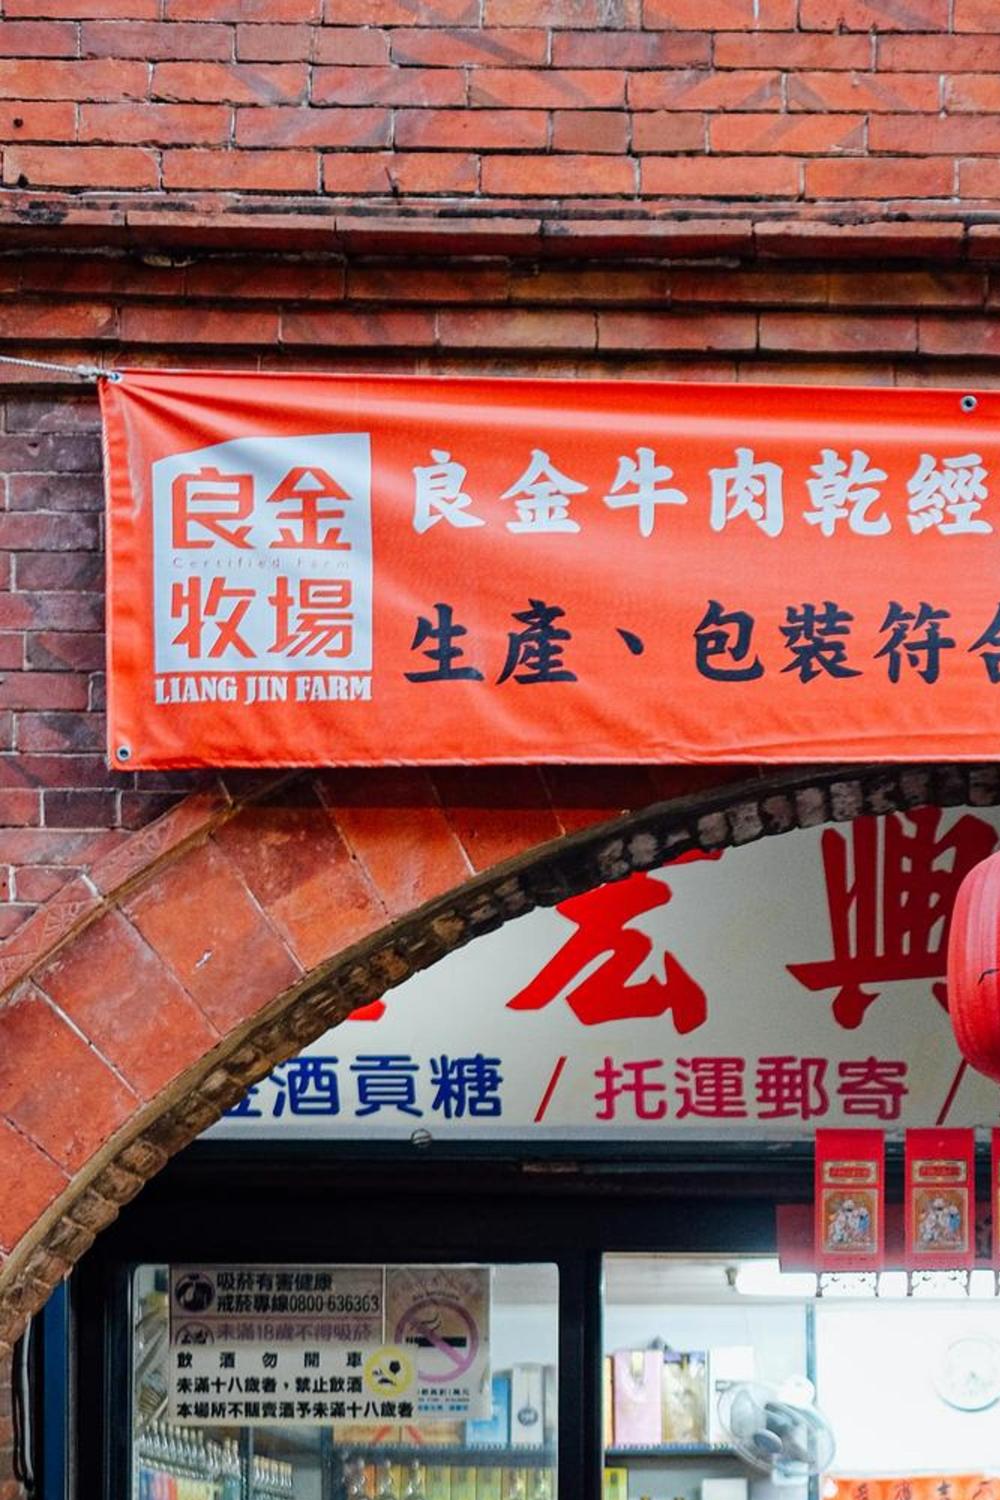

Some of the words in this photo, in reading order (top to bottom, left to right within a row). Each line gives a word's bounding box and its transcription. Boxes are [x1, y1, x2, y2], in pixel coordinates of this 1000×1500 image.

[172, 467, 353, 549] 良金
[173, 557, 280, 568] Certified
[171, 576, 354, 658] 牧場
[155, 676, 237, 704] LIANG
[244, 675, 288, 705] JIN
[296, 675, 373, 702] FARM
[595, 1055, 909, 1122] 托運郵寄
[217, 1272, 334, 1291] 吸菸有害健康
